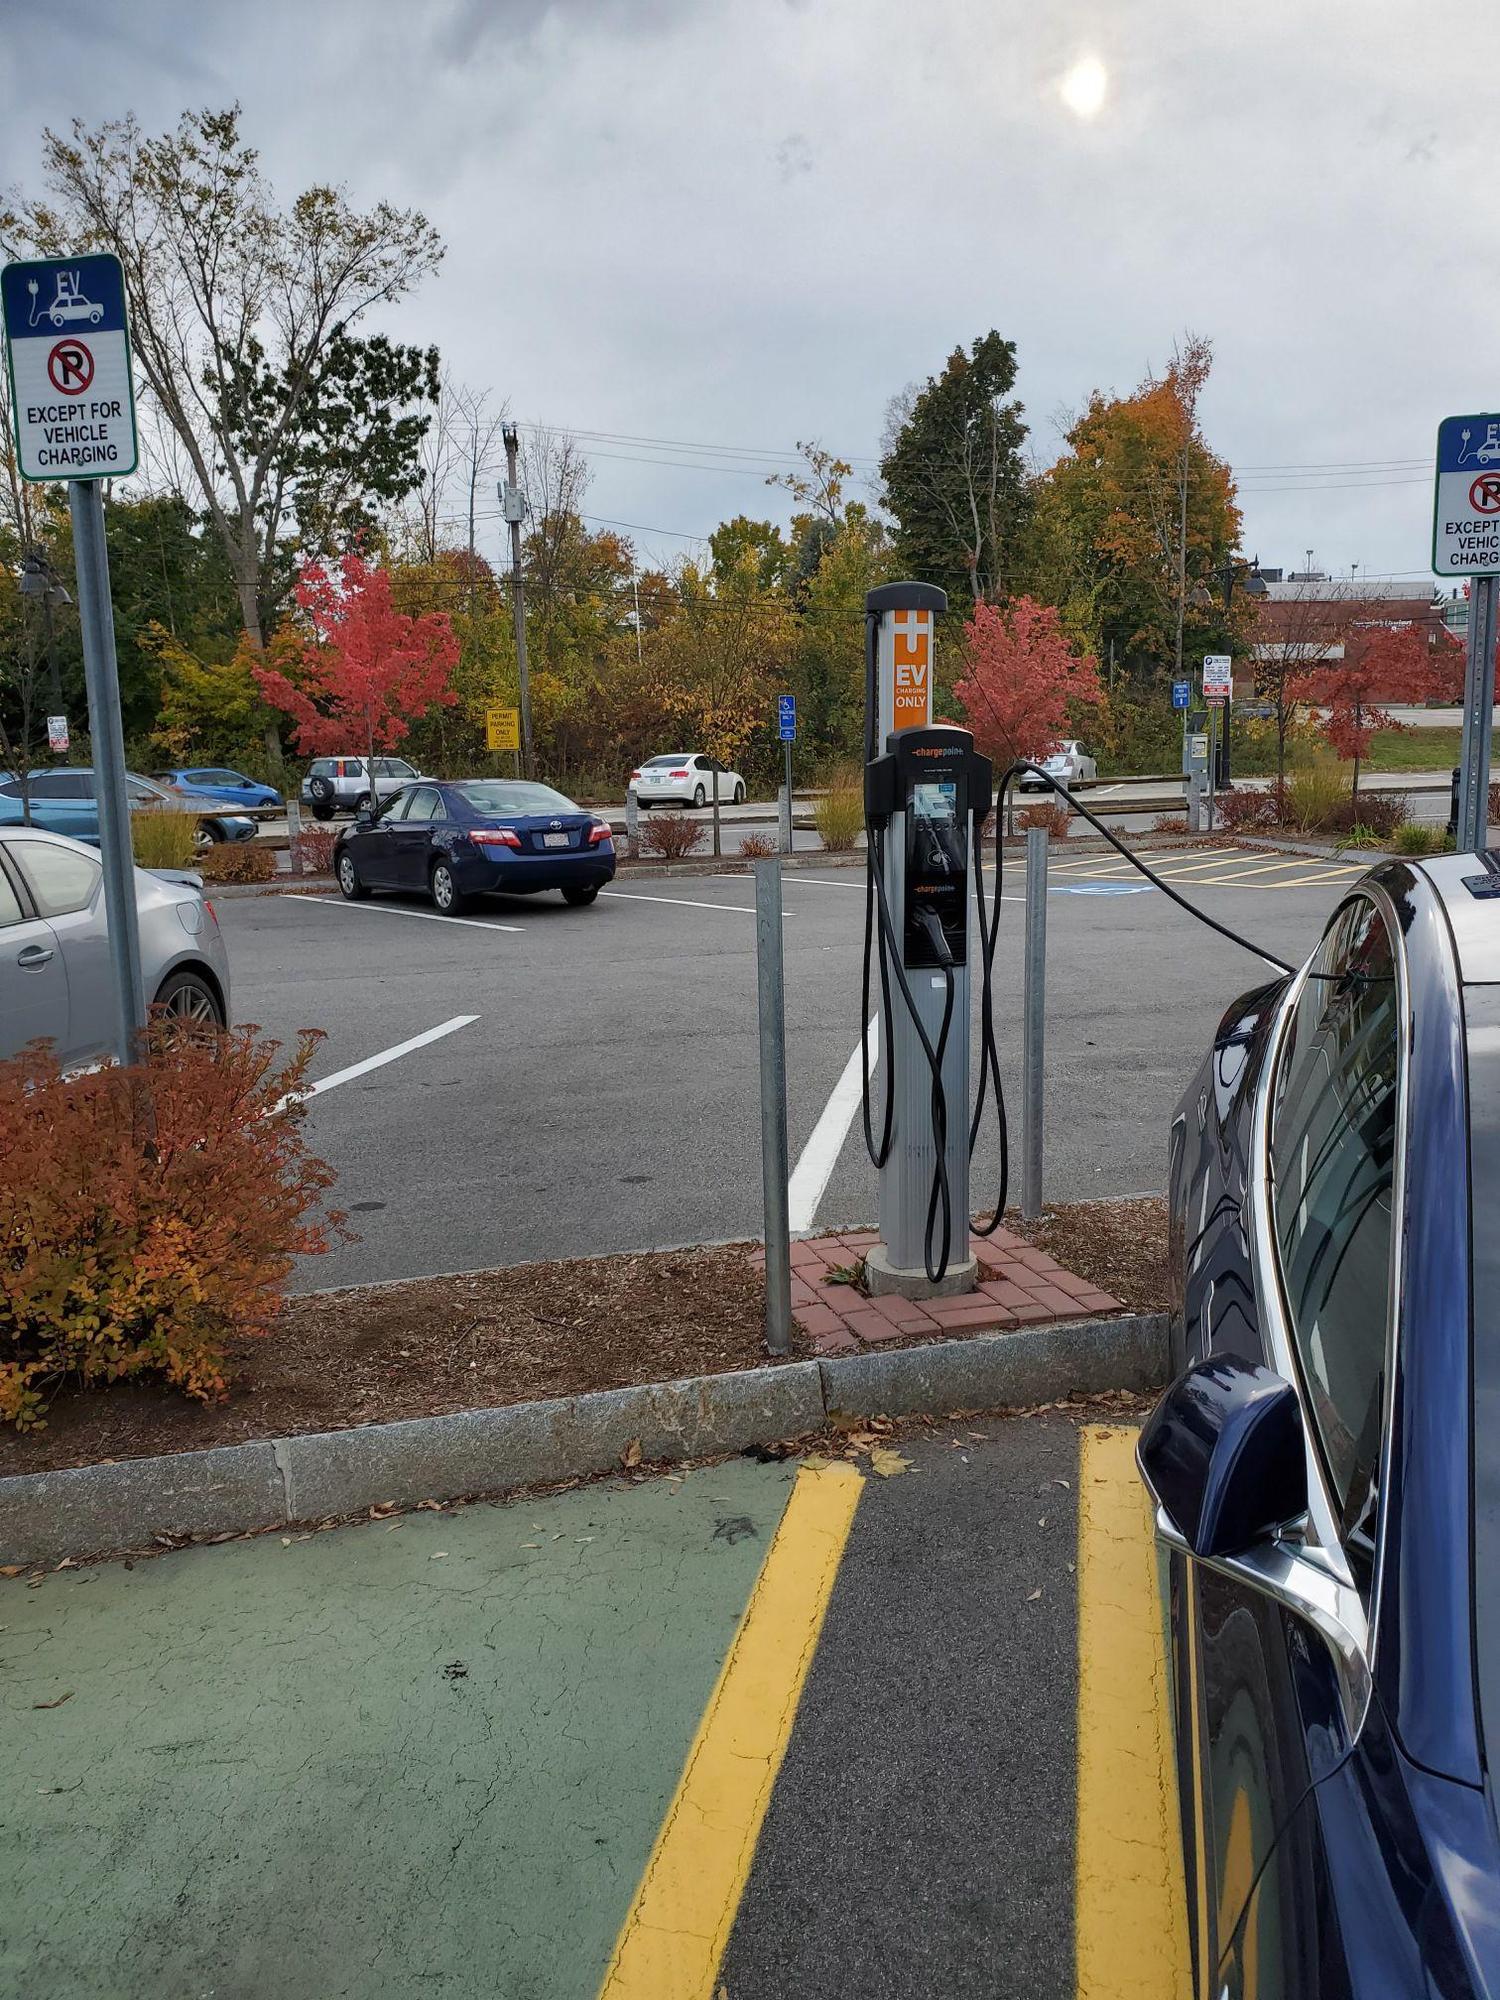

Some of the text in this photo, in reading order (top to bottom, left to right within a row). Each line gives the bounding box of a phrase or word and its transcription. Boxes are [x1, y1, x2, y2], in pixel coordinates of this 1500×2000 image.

[56, 270, 81, 298] EV
[28, 401, 122, 424] EXCEPT FOR
[44, 424, 108, 444] VEHICLE
[1487, 424, 1500, 444] E
[38, 444, 118, 466] CHARGING
[1445, 520, 1500, 535] EXCEPT
[896, 664, 927, 686] EV
[896, 696, 927, 708] ONLY
